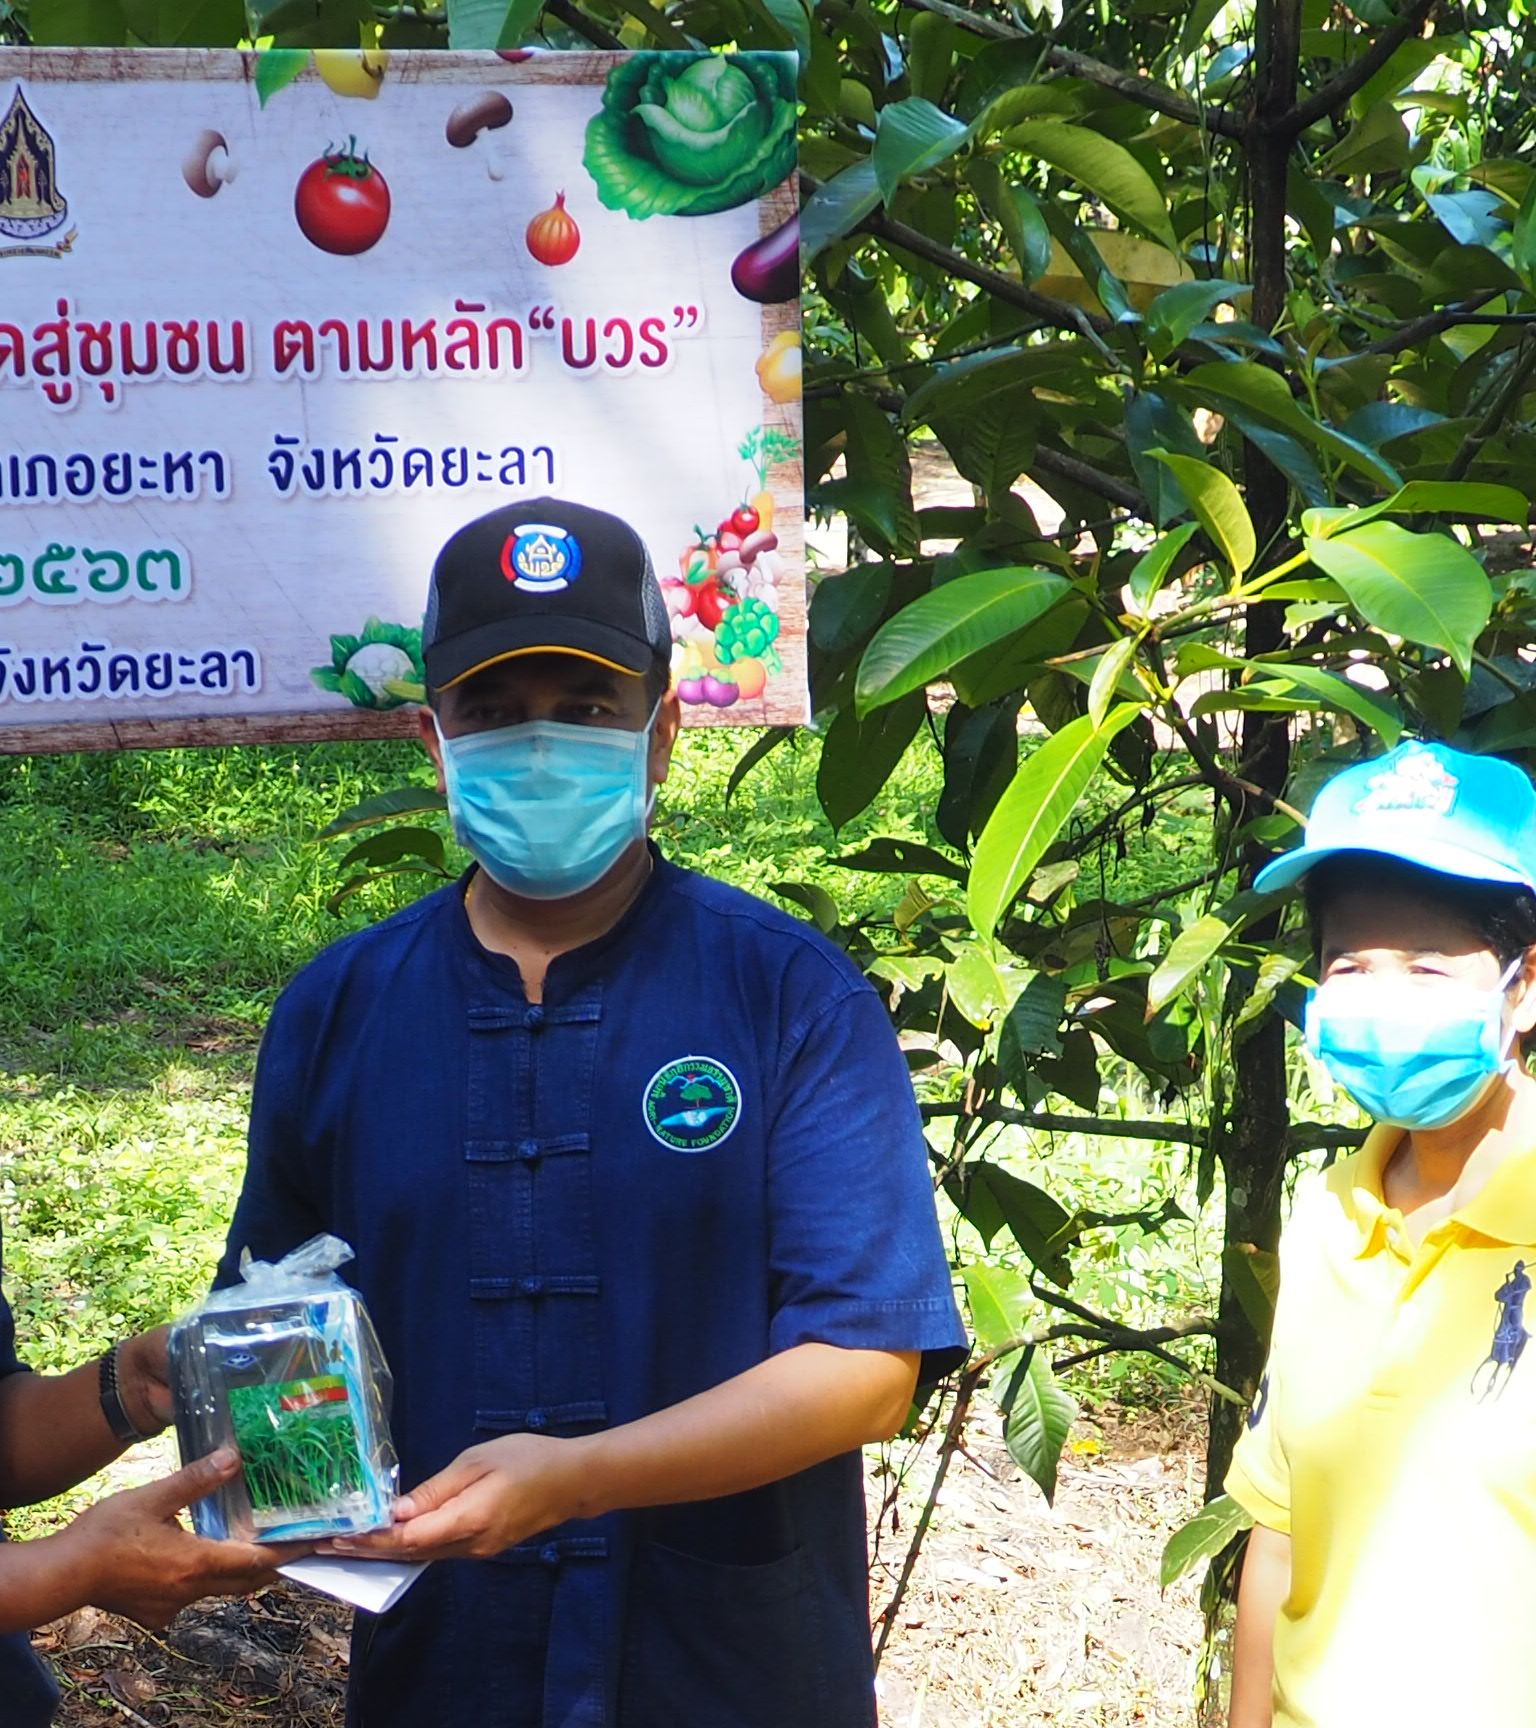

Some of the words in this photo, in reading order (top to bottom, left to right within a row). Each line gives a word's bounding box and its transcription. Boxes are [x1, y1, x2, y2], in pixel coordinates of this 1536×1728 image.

[267, 432, 555, 491] จังหวัดยะลา
[690, 1106, 736, 1147] FOUNDATION
